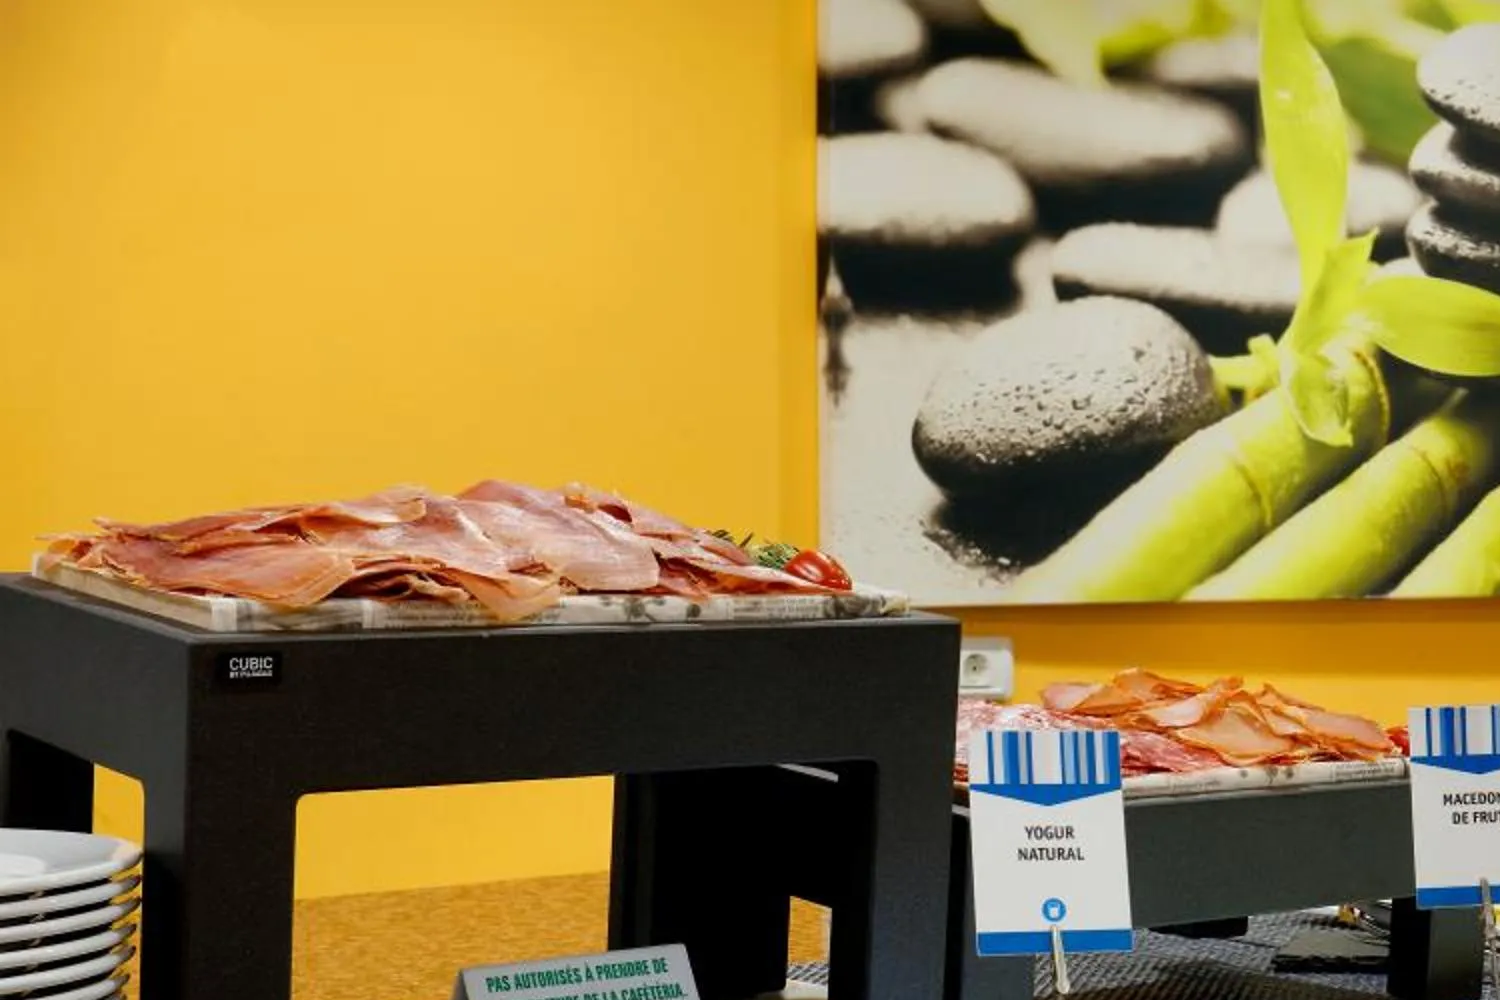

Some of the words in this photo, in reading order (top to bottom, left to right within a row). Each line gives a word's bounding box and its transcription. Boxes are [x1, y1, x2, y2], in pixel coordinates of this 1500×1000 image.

[229, 656, 273, 671] CUBIC
[1452, 812, 1469, 825] DE
[1024, 825, 1075, 840] YOGUR
[1017, 847, 1085, 861] NATURAL
[485, 975, 511, 993] PAS
[595, 959, 650, 980] PRENDRE
[651, 957, 668, 974] DE
